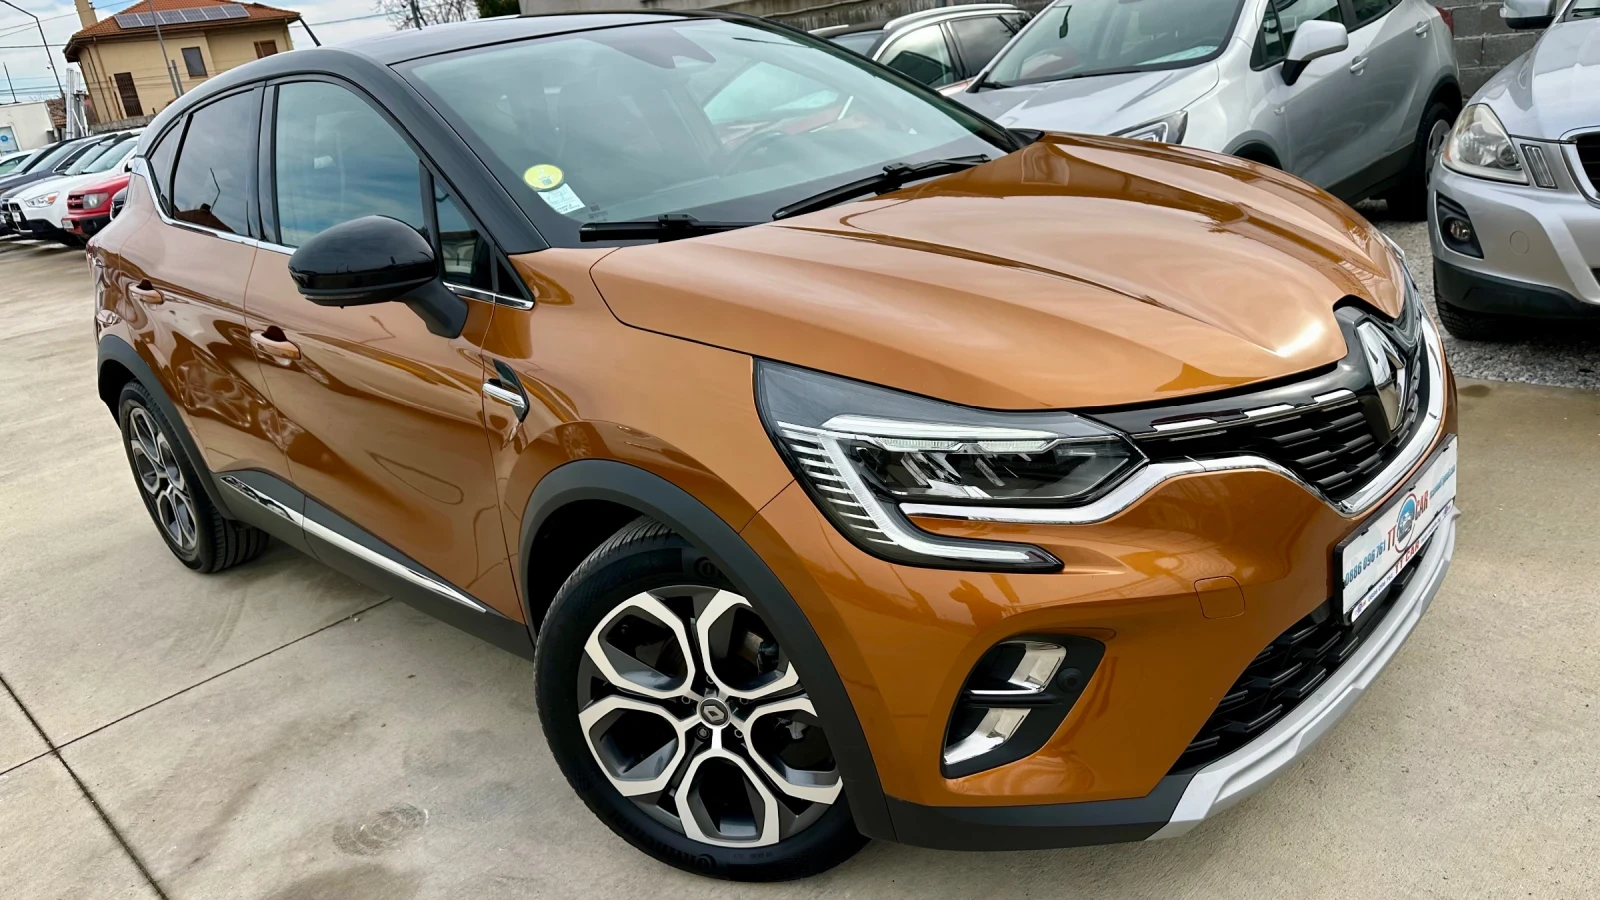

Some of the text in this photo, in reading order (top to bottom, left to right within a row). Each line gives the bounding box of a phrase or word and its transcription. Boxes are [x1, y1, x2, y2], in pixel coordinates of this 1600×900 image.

[1344, 561, 1362, 587] 0886
[1363, 549, 1375, 570] 096
[1376, 539, 1386, 558] 761
[1387, 525, 1397, 551] TT
[1415, 490, 1429, 520] CAR
[1405, 541, 1420, 562] CAR
